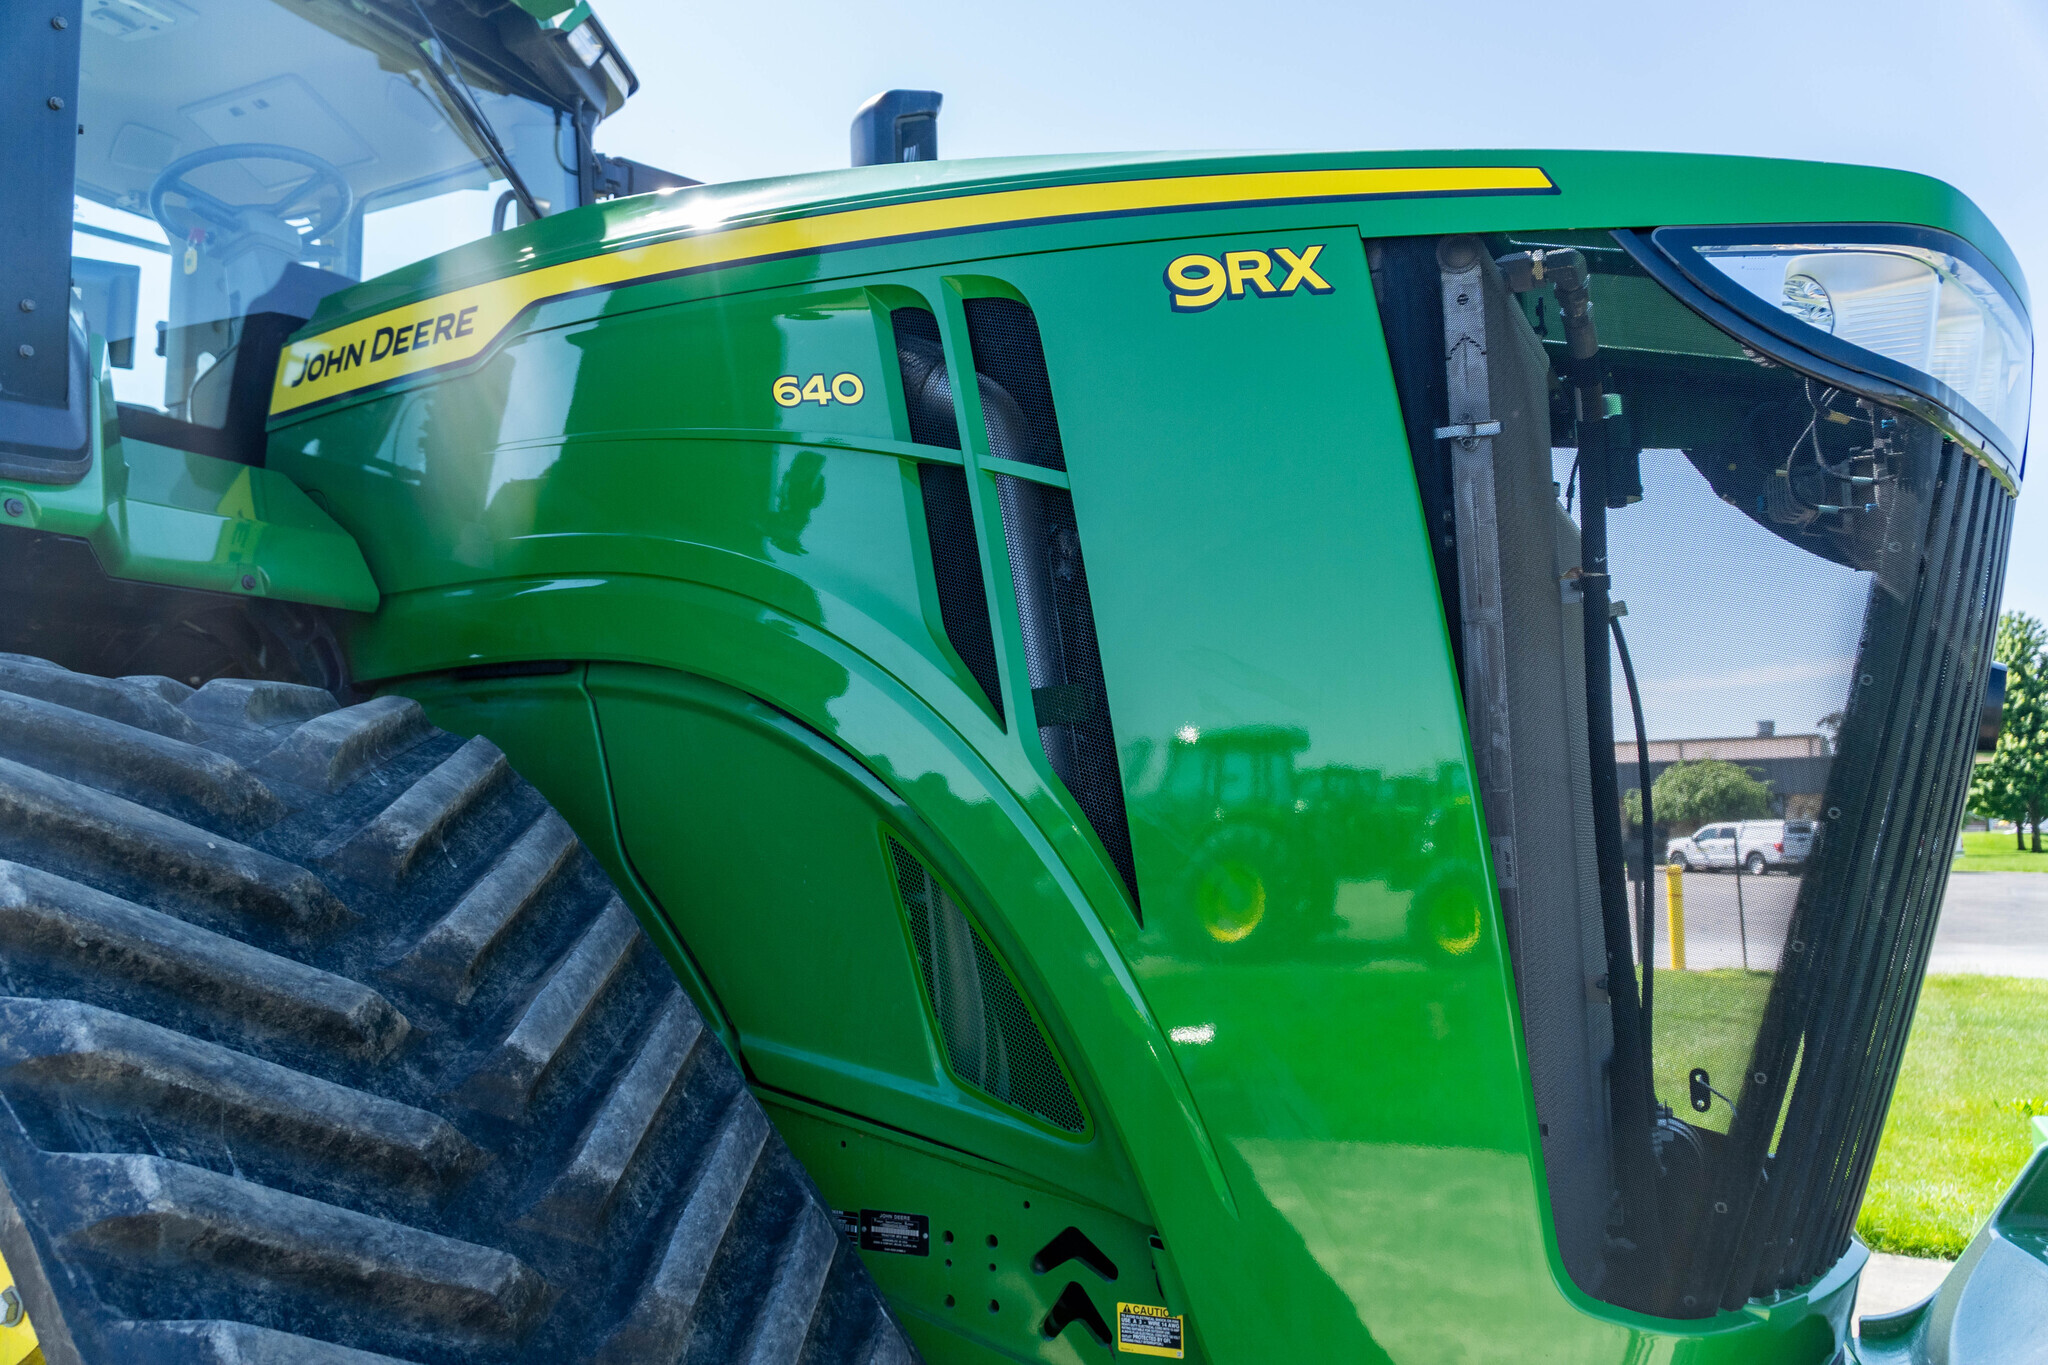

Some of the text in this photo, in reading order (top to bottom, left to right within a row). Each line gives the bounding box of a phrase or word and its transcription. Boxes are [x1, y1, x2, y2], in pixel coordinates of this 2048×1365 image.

[1163, 244, 1336, 313] 9RX
[291, 305, 478, 388] JOHN DEERE
[772, 371, 865, 409] 640
[1133, 1305, 1170, 1317] CAUTIO
